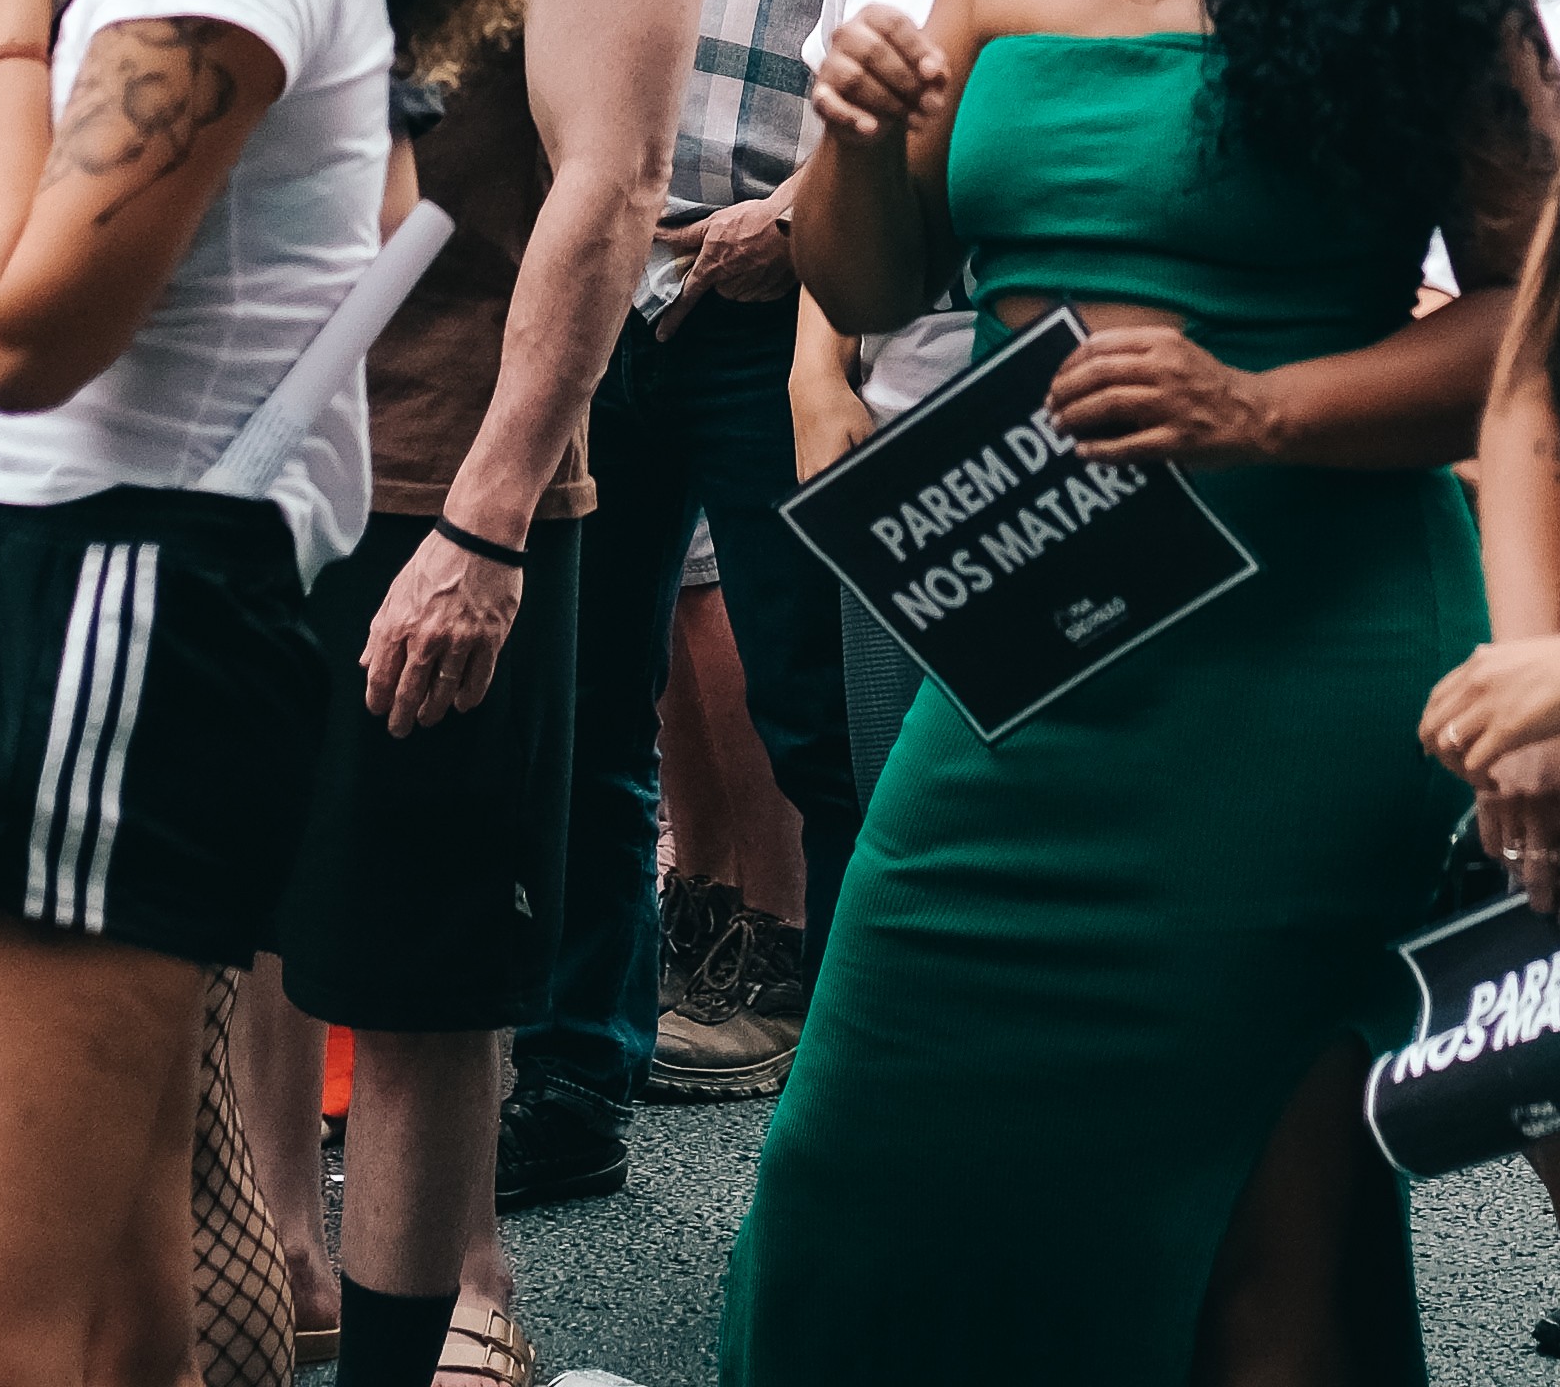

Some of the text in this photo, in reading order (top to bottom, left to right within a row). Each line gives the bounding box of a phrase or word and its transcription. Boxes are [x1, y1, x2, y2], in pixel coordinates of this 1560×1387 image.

[870, 407, 1077, 563] PAREM DE
[891, 548, 993, 631] NOS
[1393, 1024, 1487, 1084] NOS
